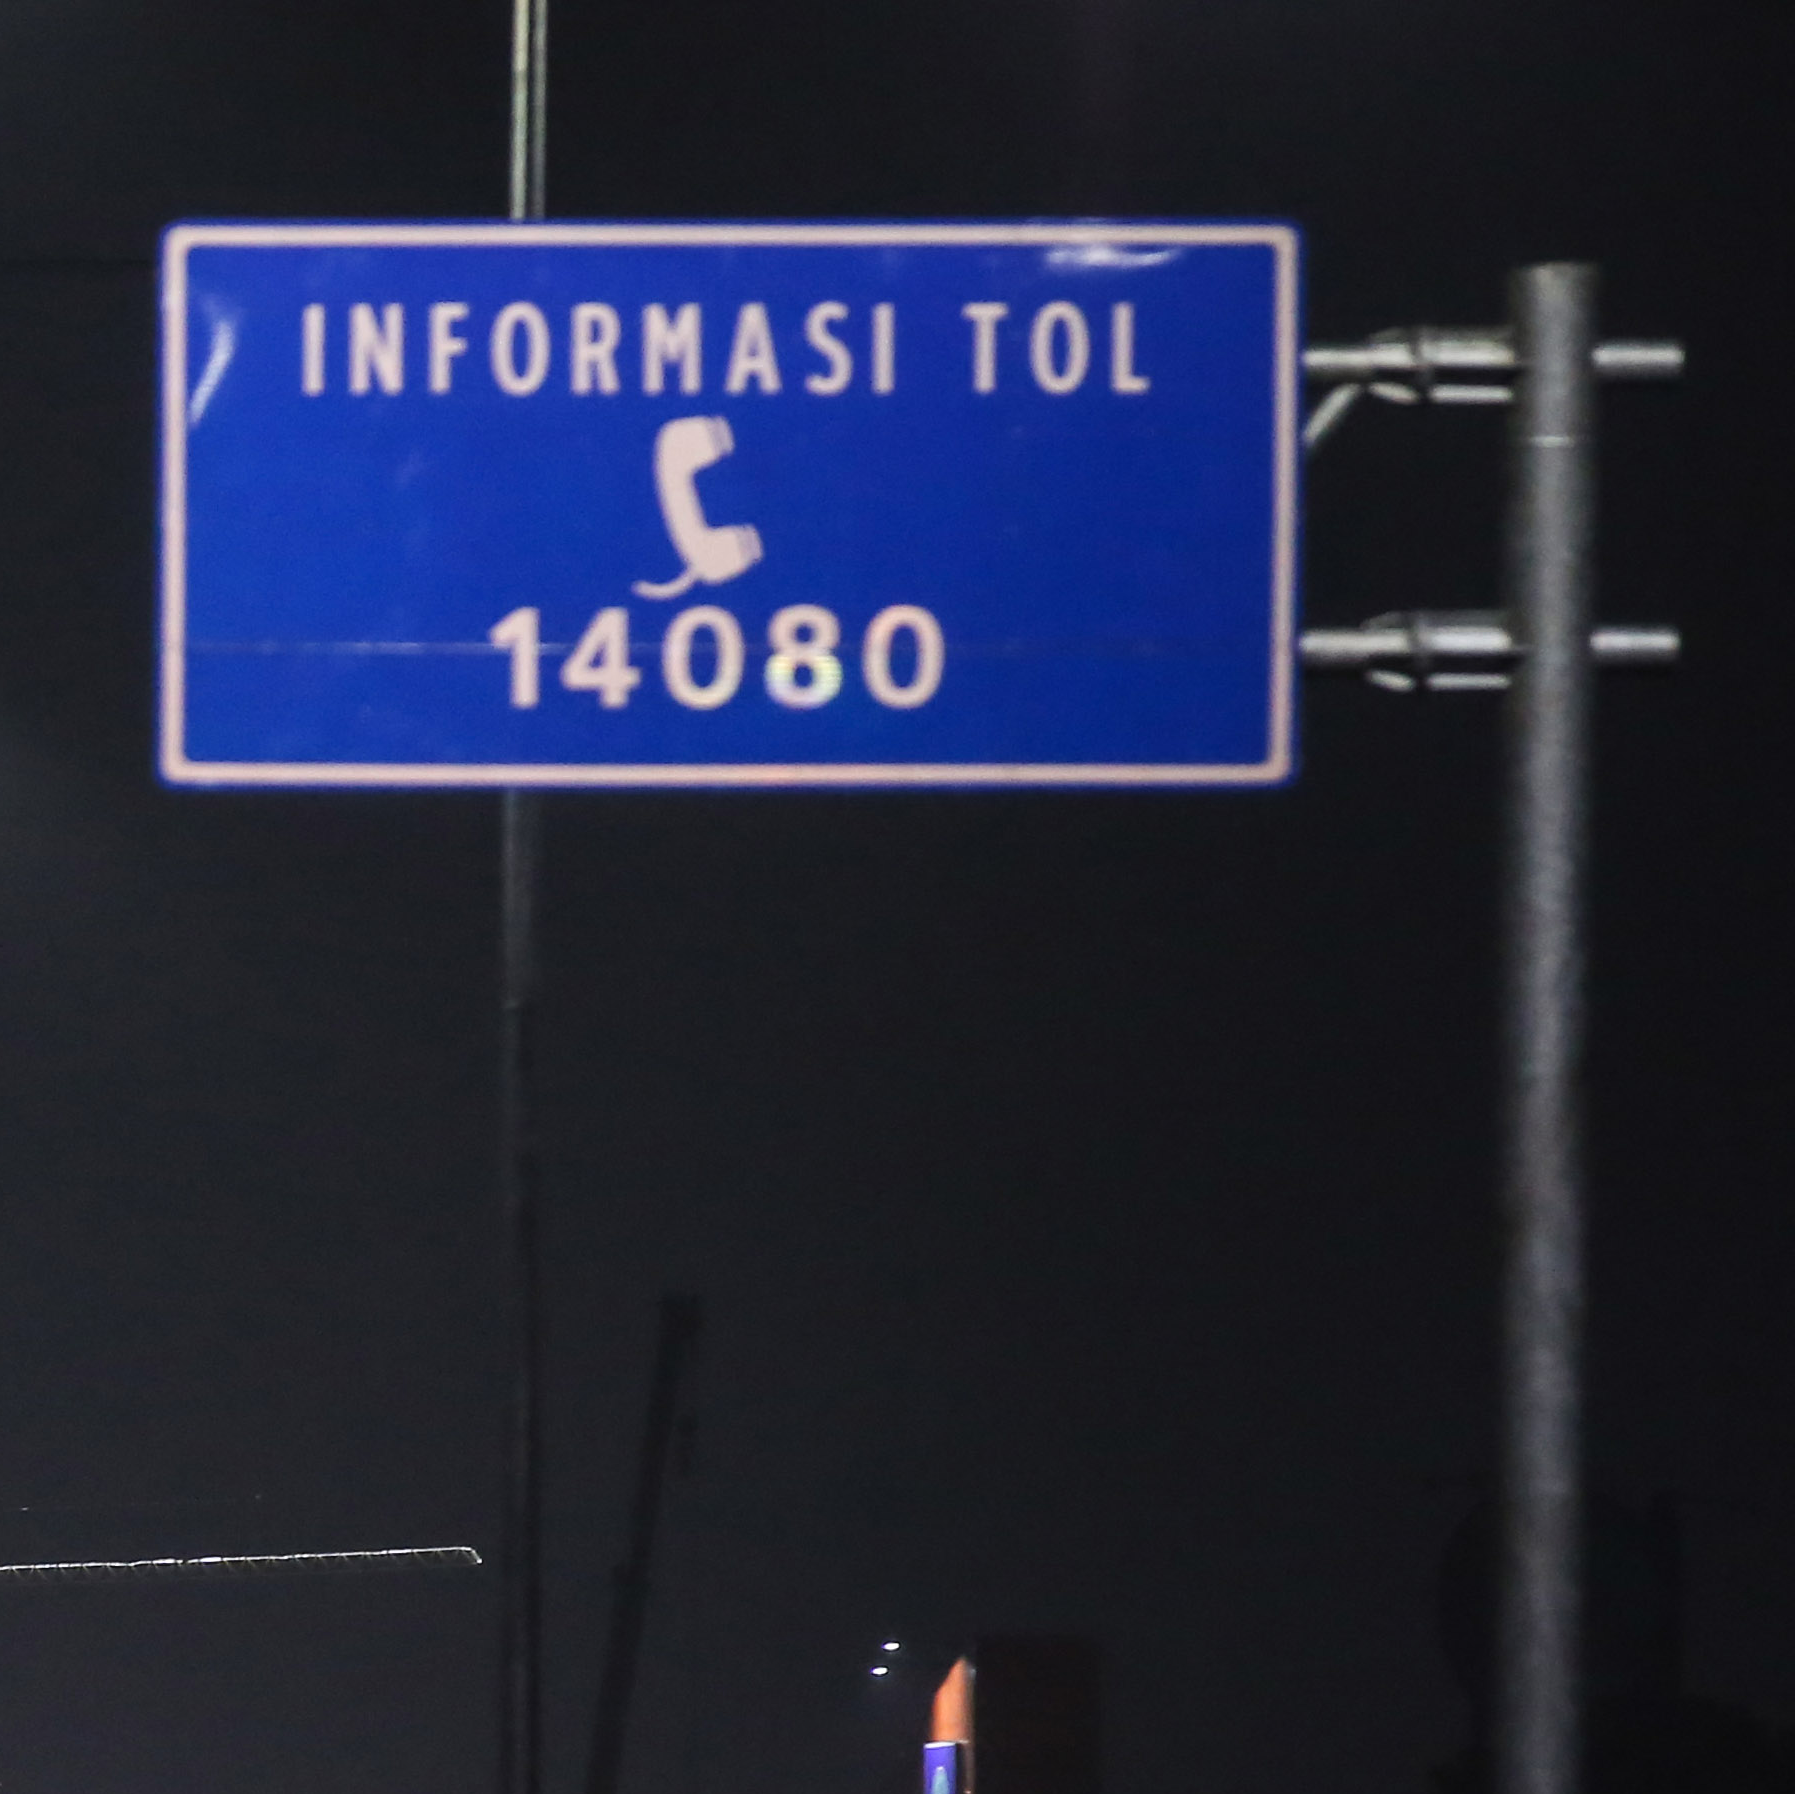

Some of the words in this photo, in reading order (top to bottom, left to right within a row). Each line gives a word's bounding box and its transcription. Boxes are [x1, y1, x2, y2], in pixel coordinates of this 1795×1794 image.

[302, 301, 894, 396] INFORMASI
[962, 301, 1149, 395] TOL
[490, 604, 944, 710] 14080
